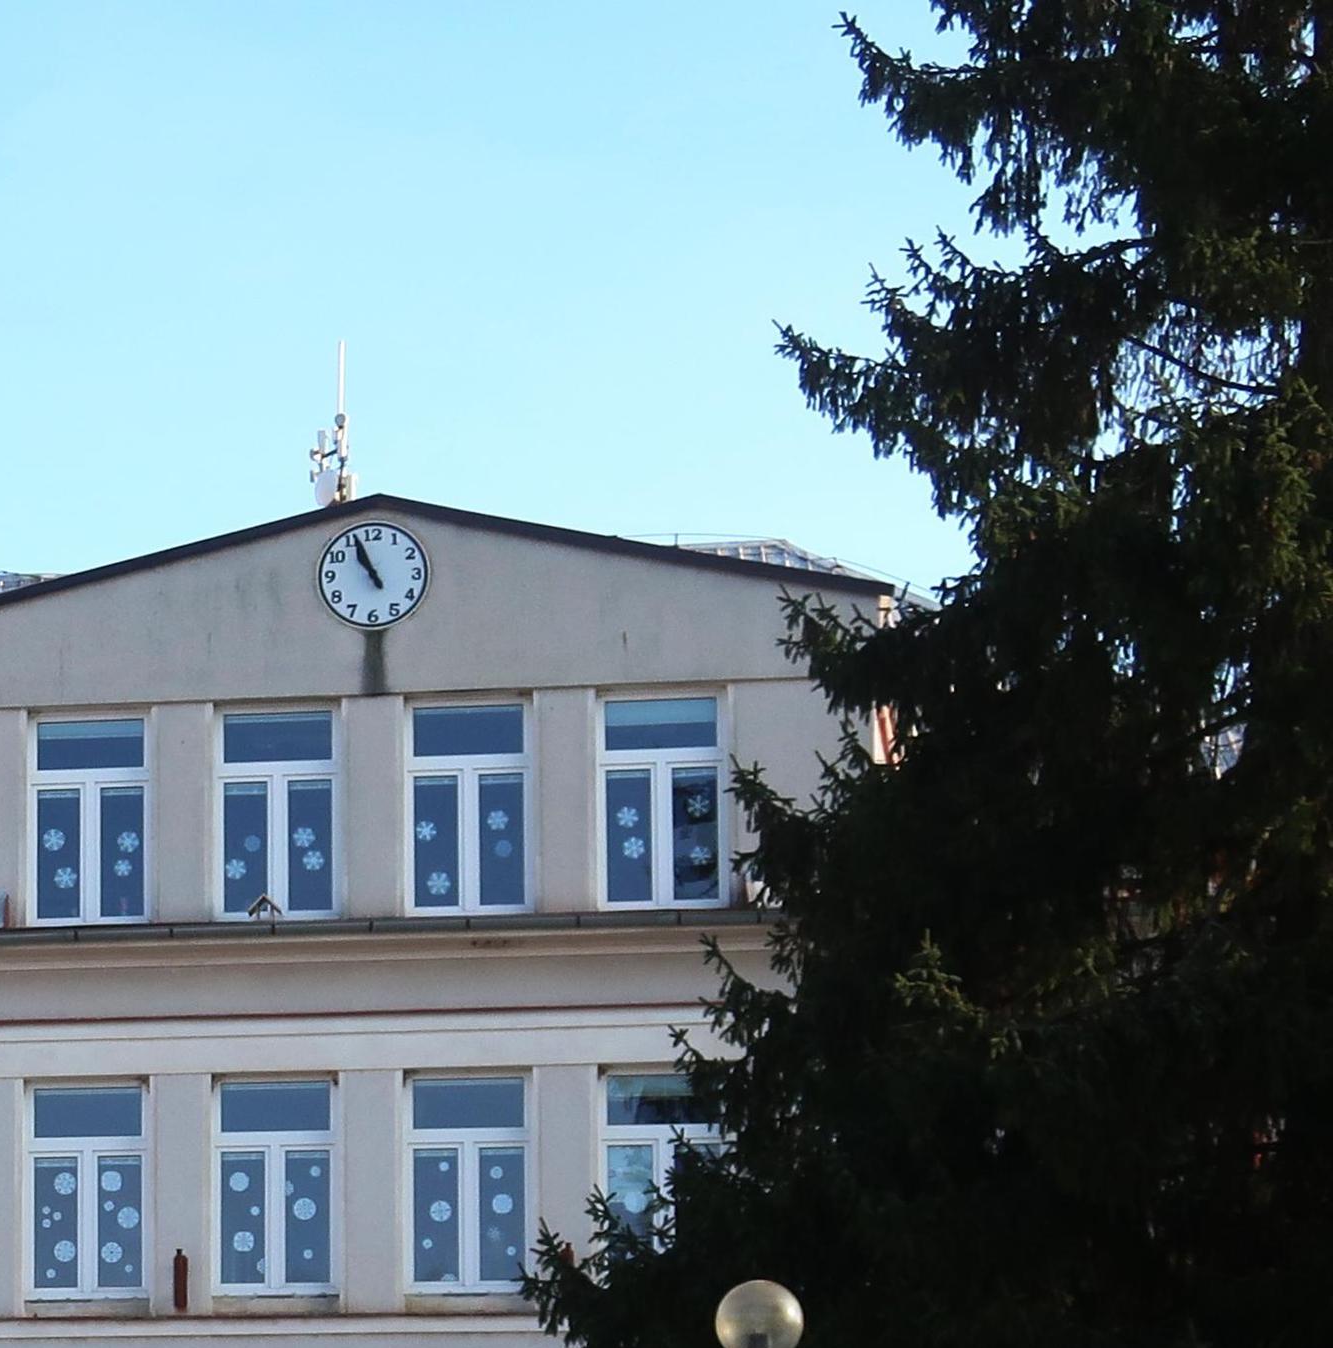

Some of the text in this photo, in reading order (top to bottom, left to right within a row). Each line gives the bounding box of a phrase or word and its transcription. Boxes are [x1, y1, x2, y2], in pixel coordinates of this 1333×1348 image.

[363, 528, 382, 542] 12
[390, 533, 398, 545] 1
[329, 550, 346, 563] 10
[405, 547, 416, 560] 2
[324, 570, 336, 583] 9
[411, 567, 422, 580] 3
[331, 590, 342, 604] 8
[404, 587, 415, 601] 4
[346, 604, 358, 618] 7
[367, 609, 379, 623] 6
[389, 603, 400, 616] 5
